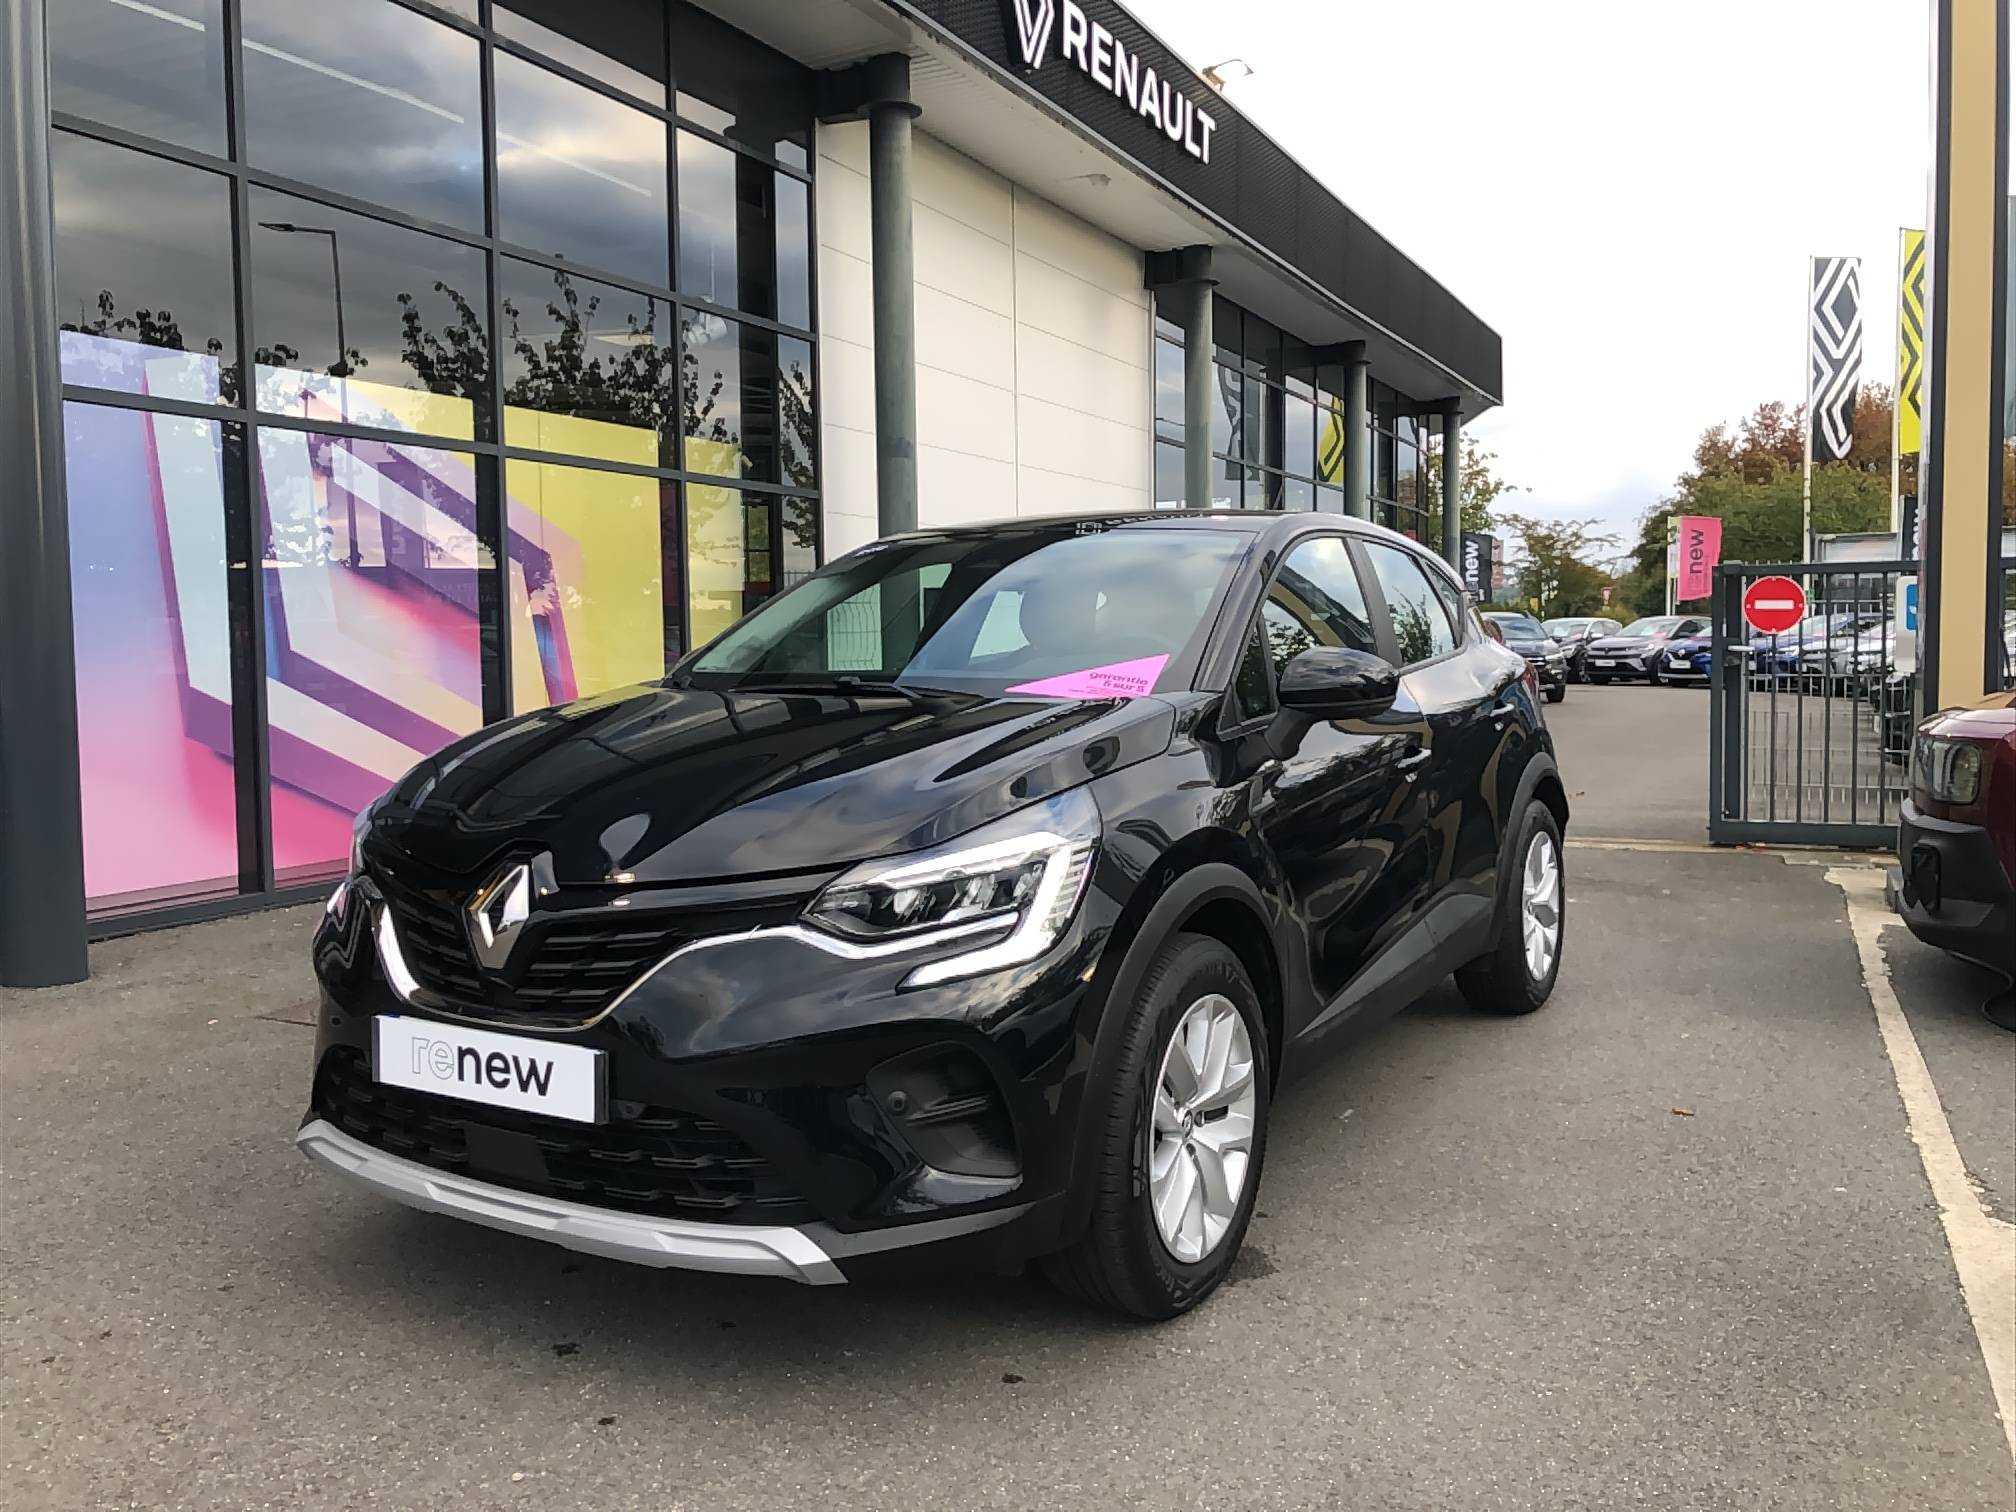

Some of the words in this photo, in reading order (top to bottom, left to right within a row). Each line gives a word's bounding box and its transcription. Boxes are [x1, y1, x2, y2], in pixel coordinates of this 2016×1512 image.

[1062, 0, 1218, 164] RENAULT
[1089, 672, 1149, 685] garantie
[411, 1036, 554, 1097] renew
